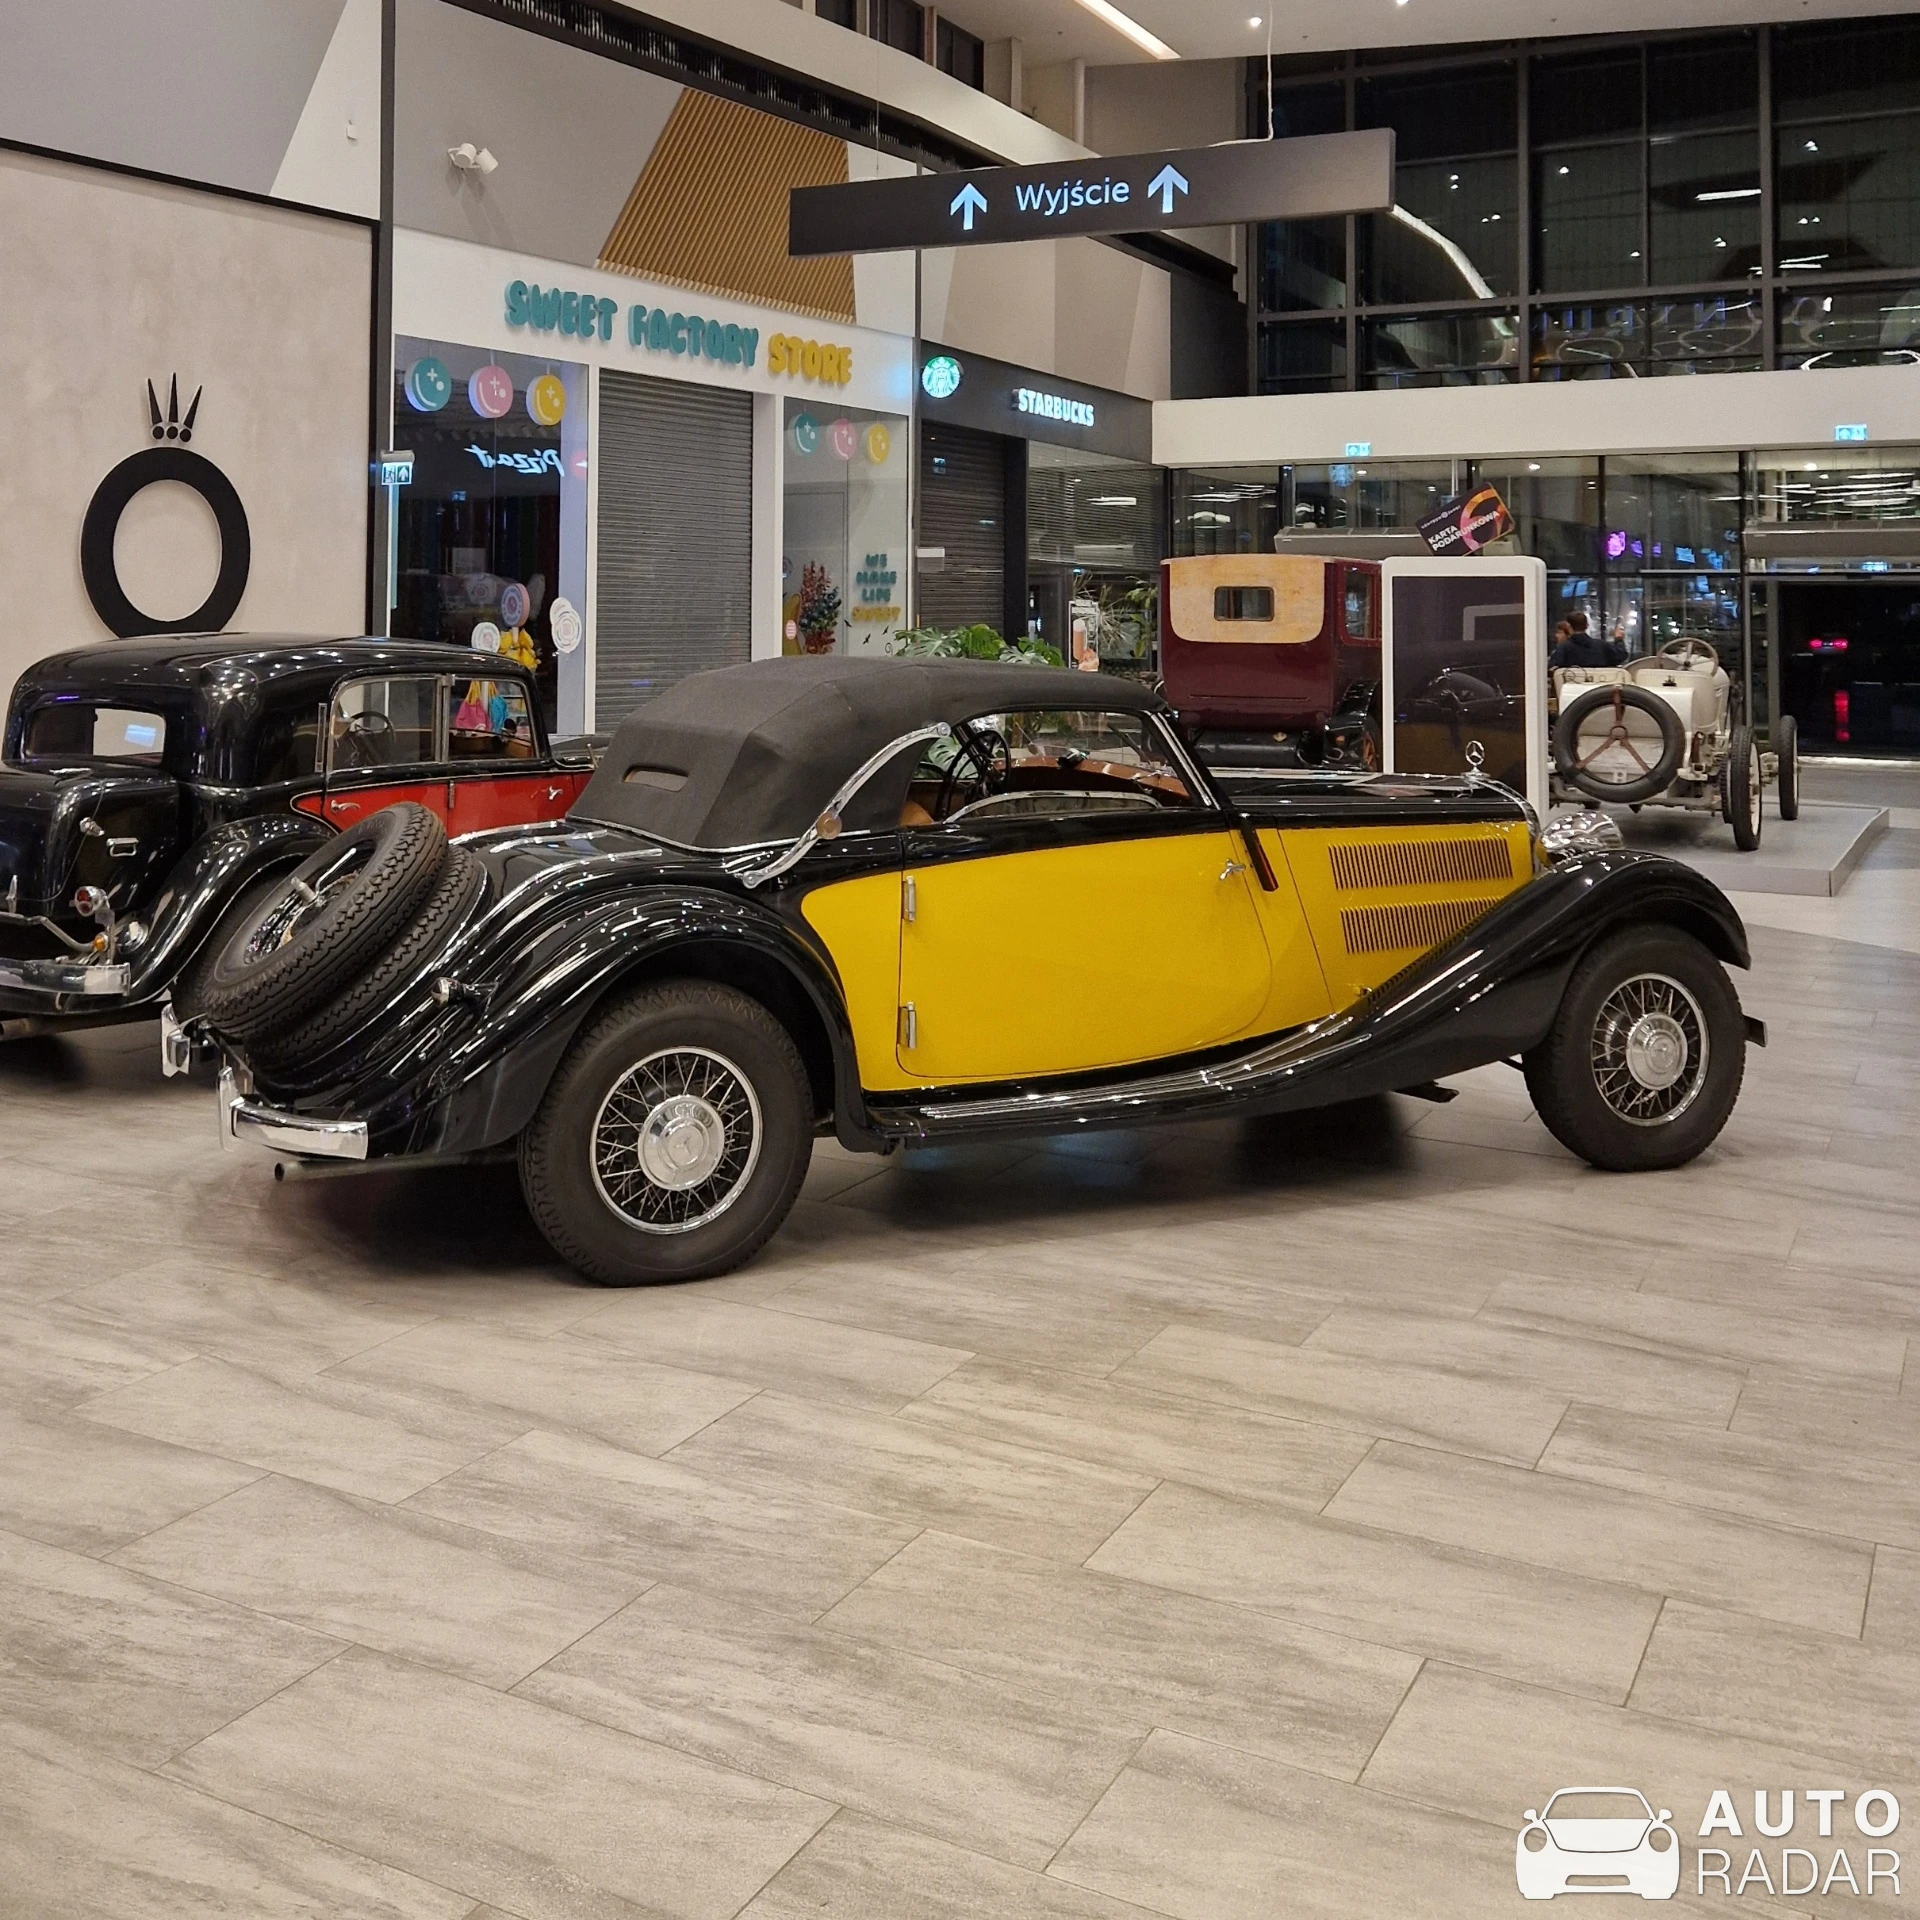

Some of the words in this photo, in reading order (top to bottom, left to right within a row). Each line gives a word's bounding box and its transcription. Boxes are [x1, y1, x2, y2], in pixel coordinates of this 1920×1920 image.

[1014, 176, 1130, 216] Wyjście
[504, 280, 618, 341] SWEET
[628, 304, 759, 367] FACTORY
[767, 332, 853, 385] STORE
[1018, 387, 1095, 427] STARBUCKS
[1428, 526, 1458, 544] KARTA
[1432, 511, 1500, 551] PODARUNKOWA
